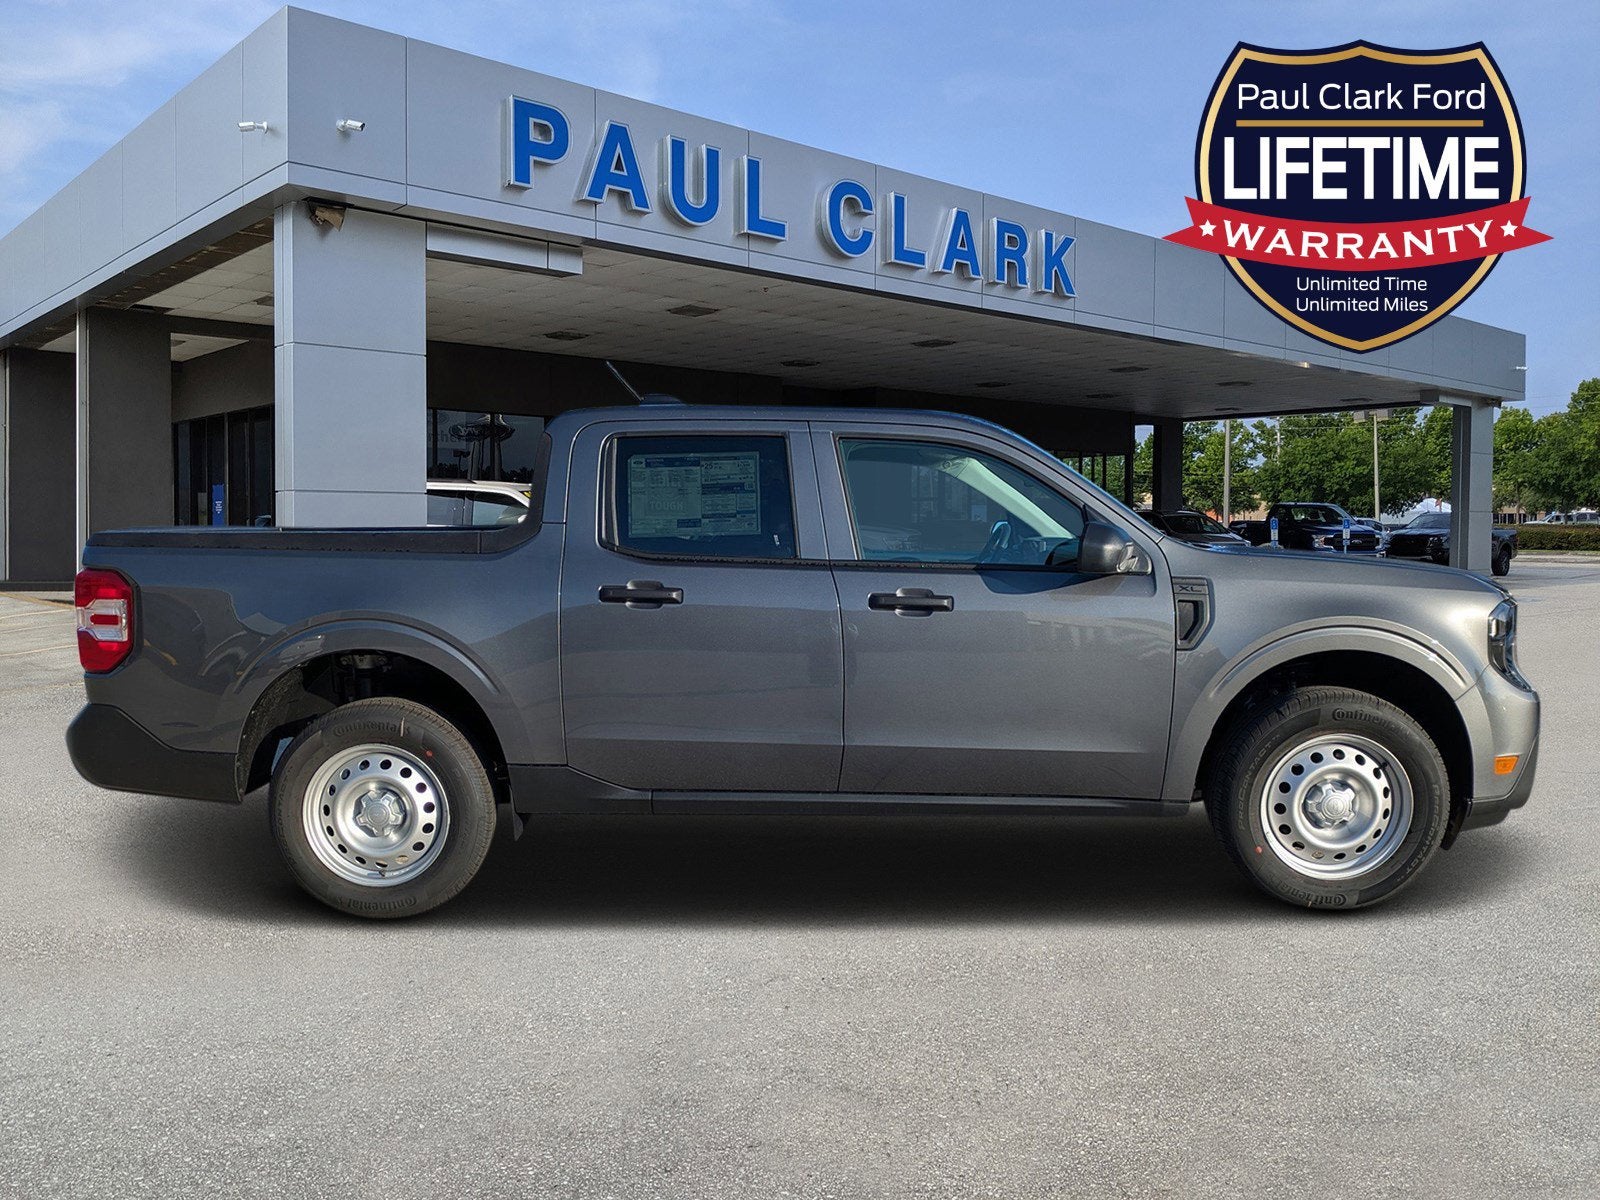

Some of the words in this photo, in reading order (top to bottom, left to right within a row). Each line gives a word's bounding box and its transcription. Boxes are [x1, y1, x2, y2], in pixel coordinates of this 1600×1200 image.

[506, 95, 788, 241] PAUL
[821, 179, 1077, 298] CLARK
[1179, 585, 1203, 593] XL
